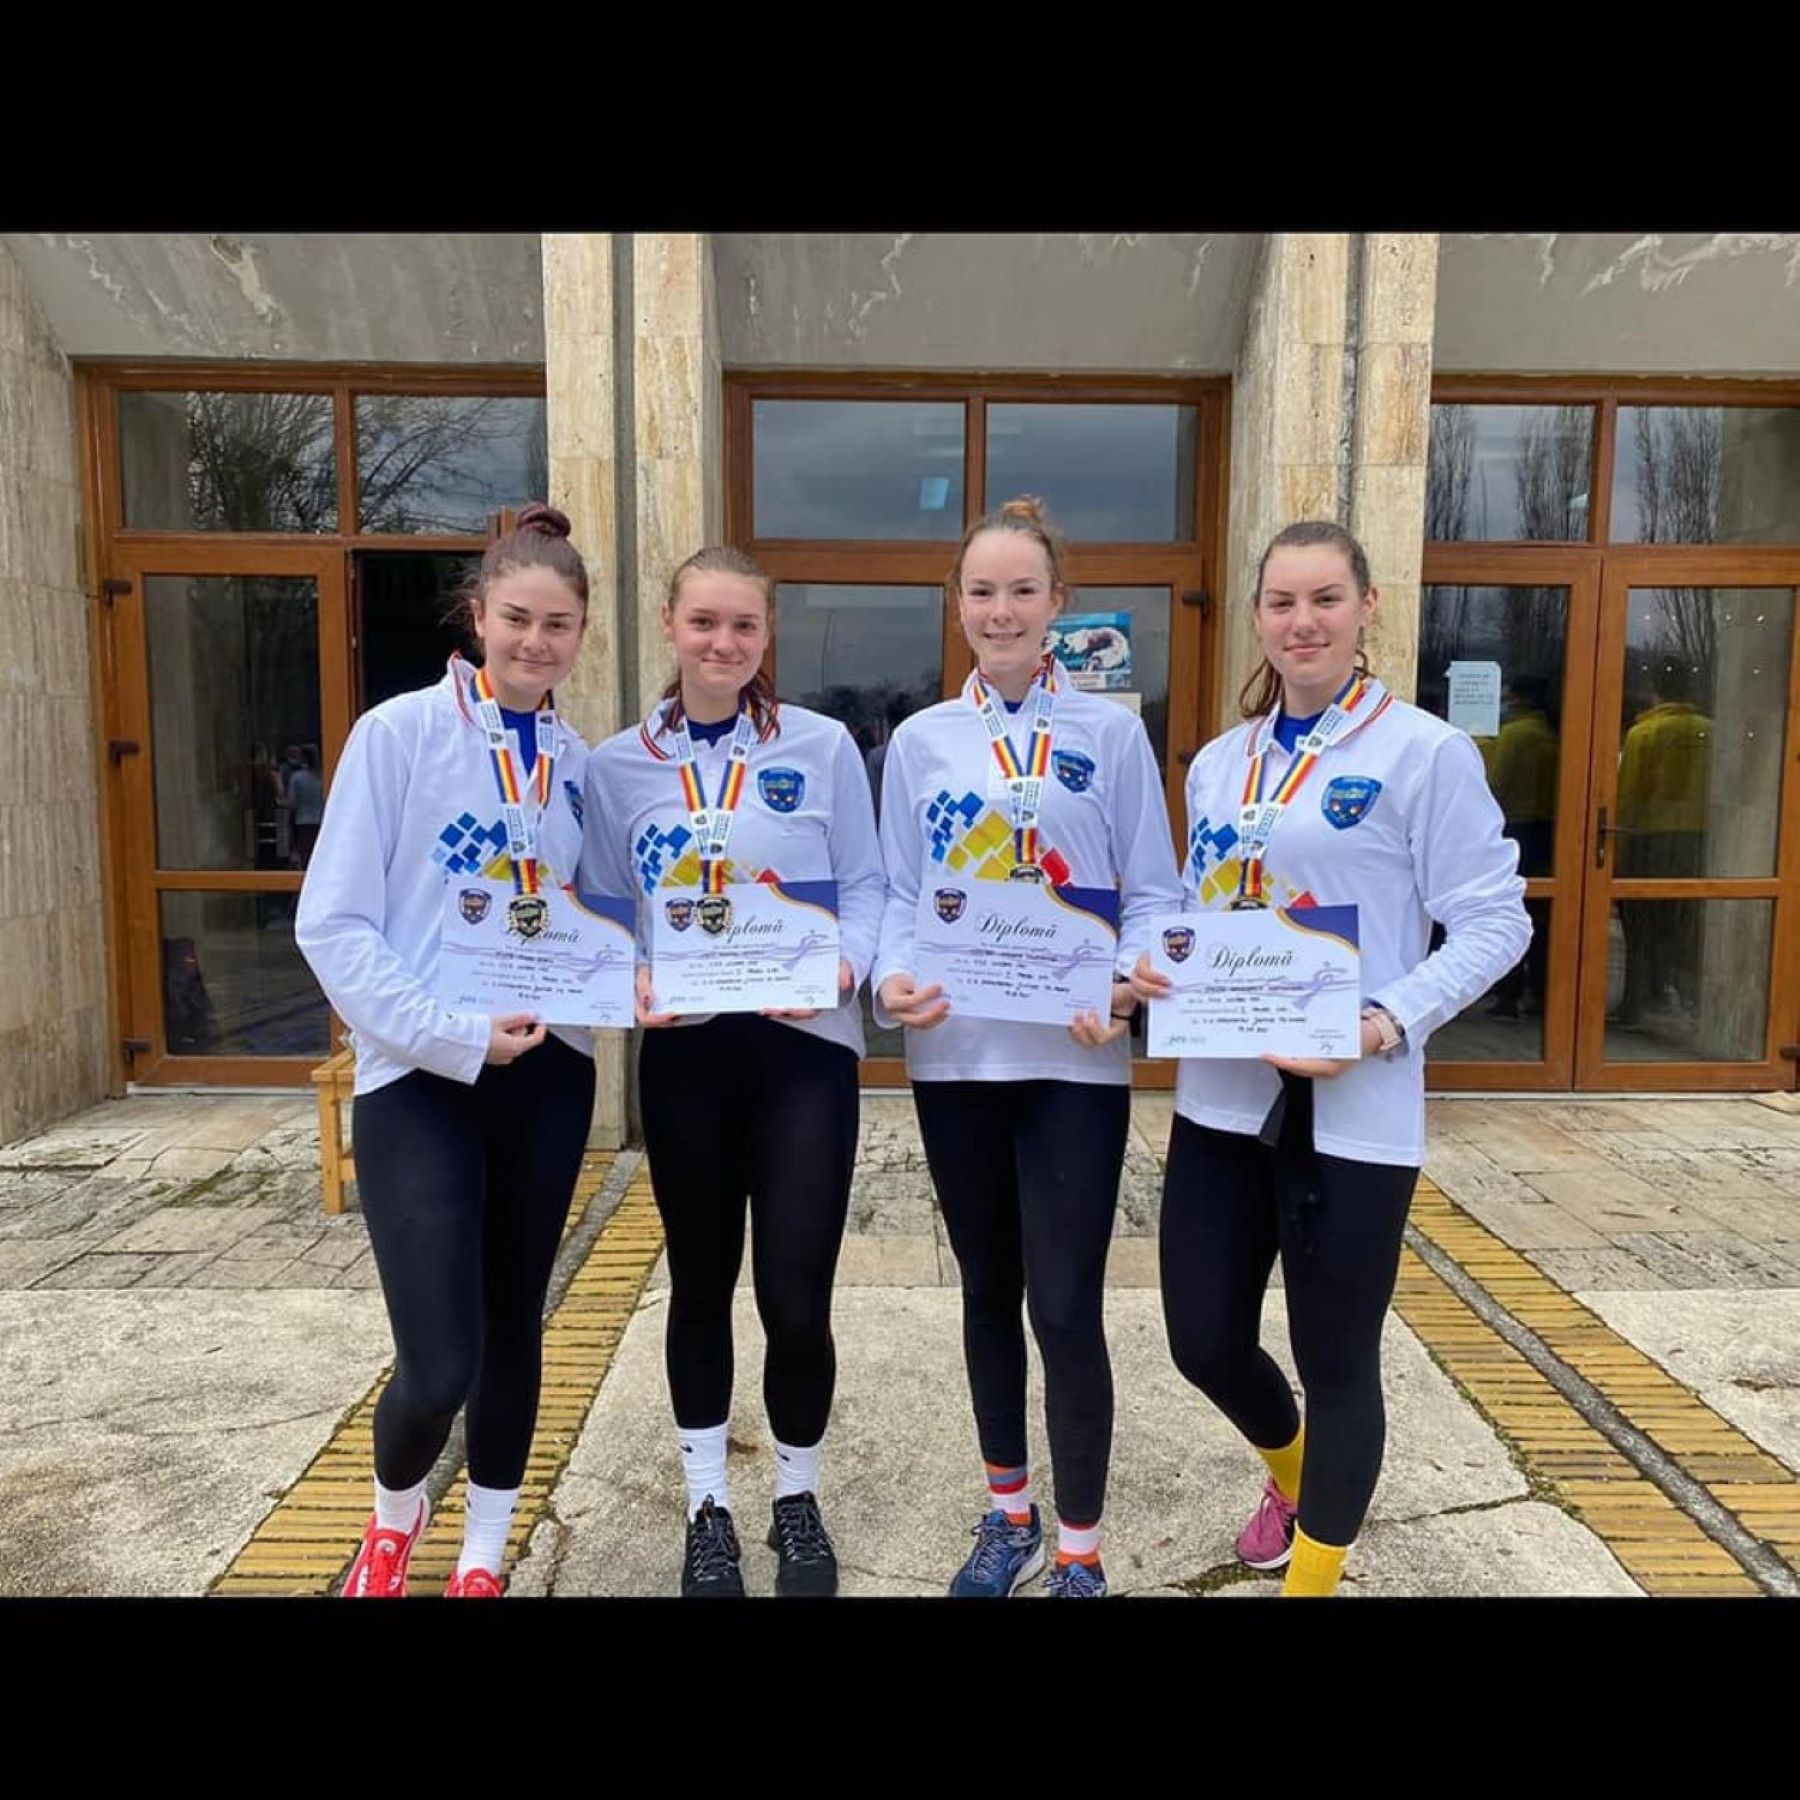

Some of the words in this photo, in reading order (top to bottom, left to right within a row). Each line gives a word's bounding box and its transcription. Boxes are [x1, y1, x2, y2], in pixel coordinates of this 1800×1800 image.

[726, 914, 787, 943] iplomă
[979, 912, 1058, 942] Diplomă
[1210, 944, 1293, 977] Diplomă
